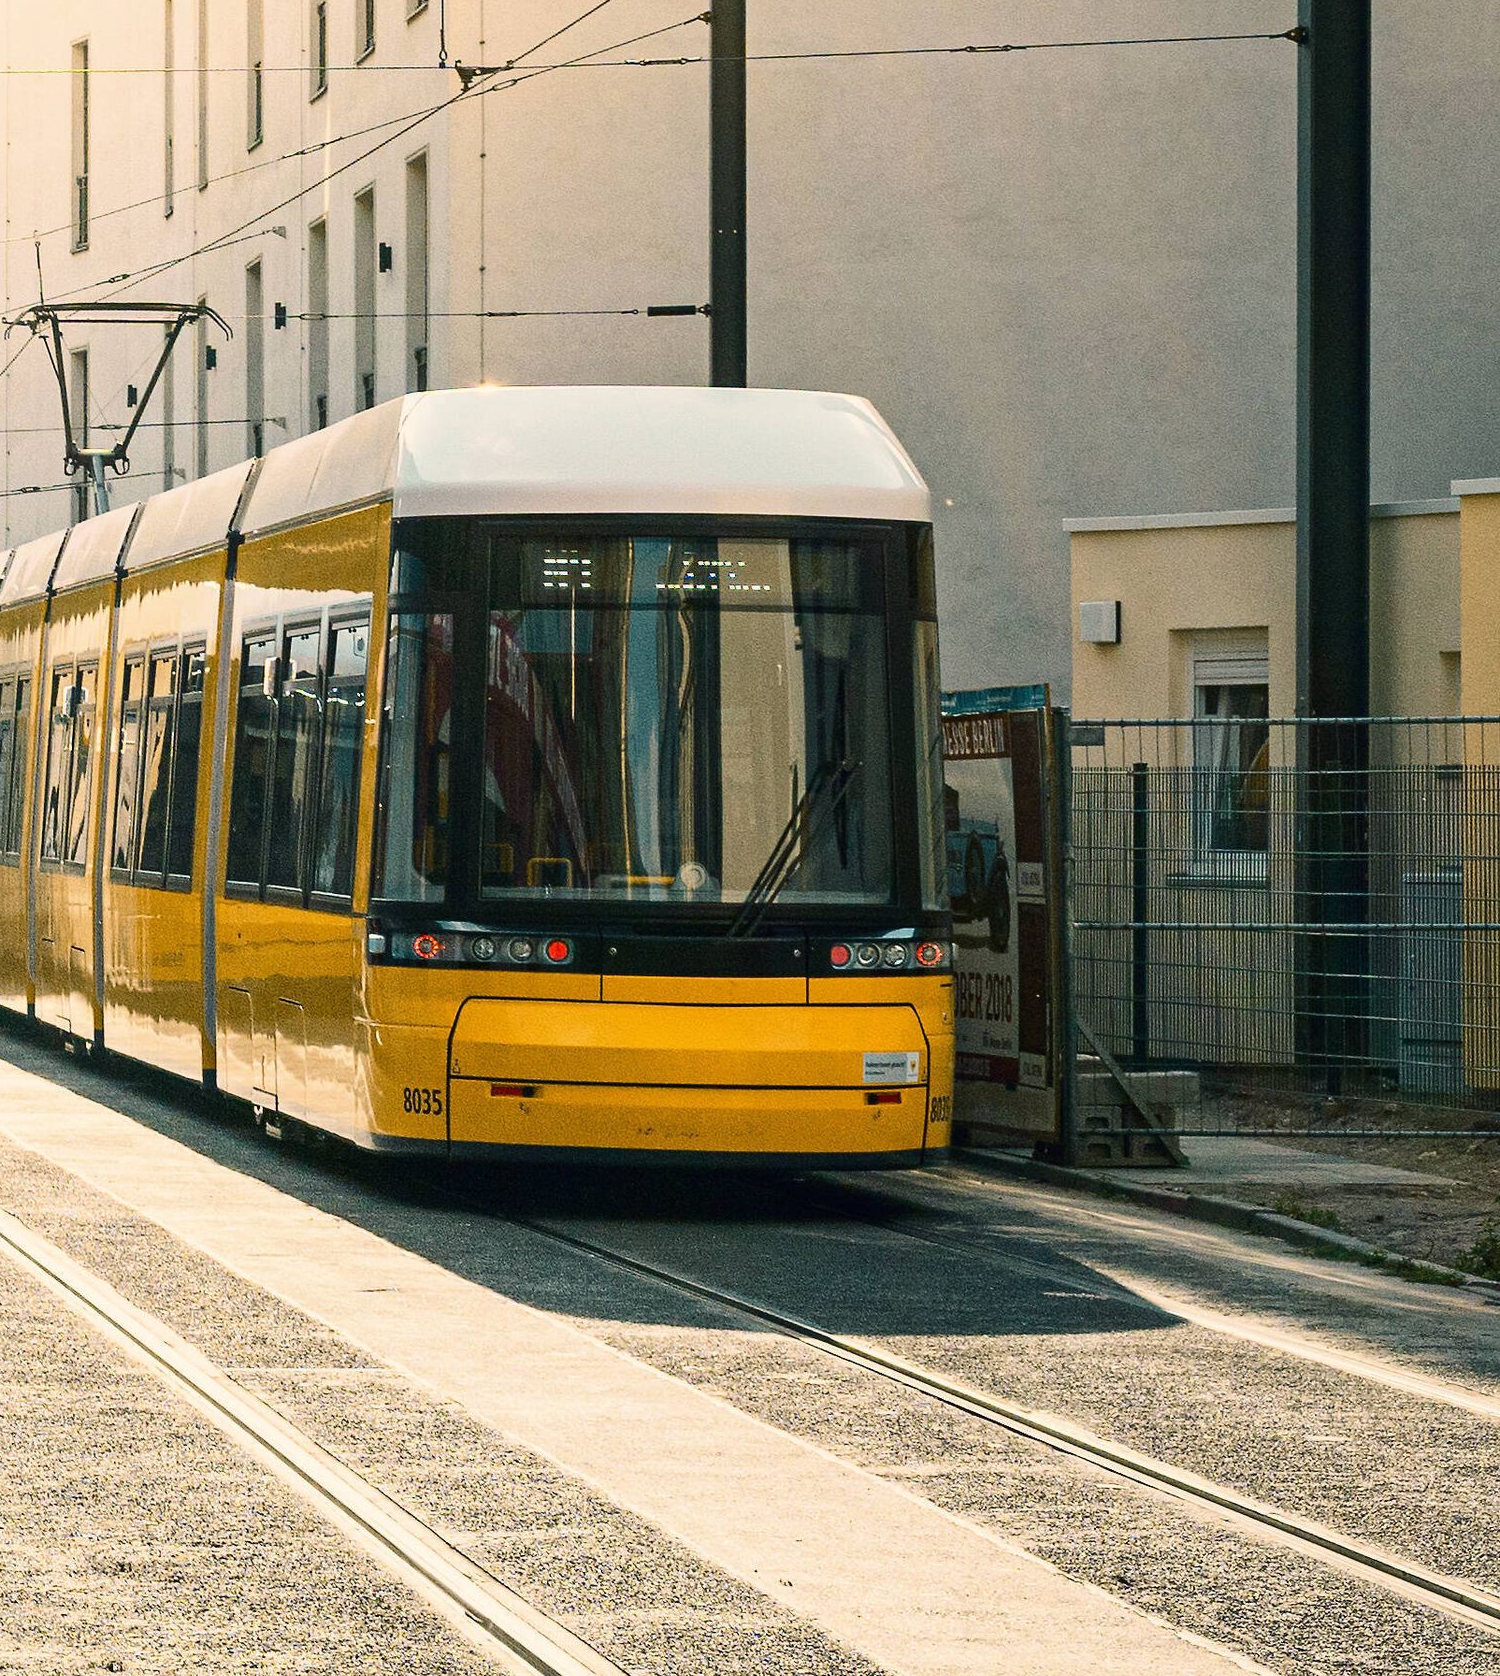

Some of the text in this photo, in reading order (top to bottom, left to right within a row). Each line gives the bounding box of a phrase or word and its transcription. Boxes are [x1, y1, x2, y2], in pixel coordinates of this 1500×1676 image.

[972, 718, 1005, 754] BERLIN
[985, 973, 1013, 1023] 2018
[403, 1087, 443, 1116] 8035
